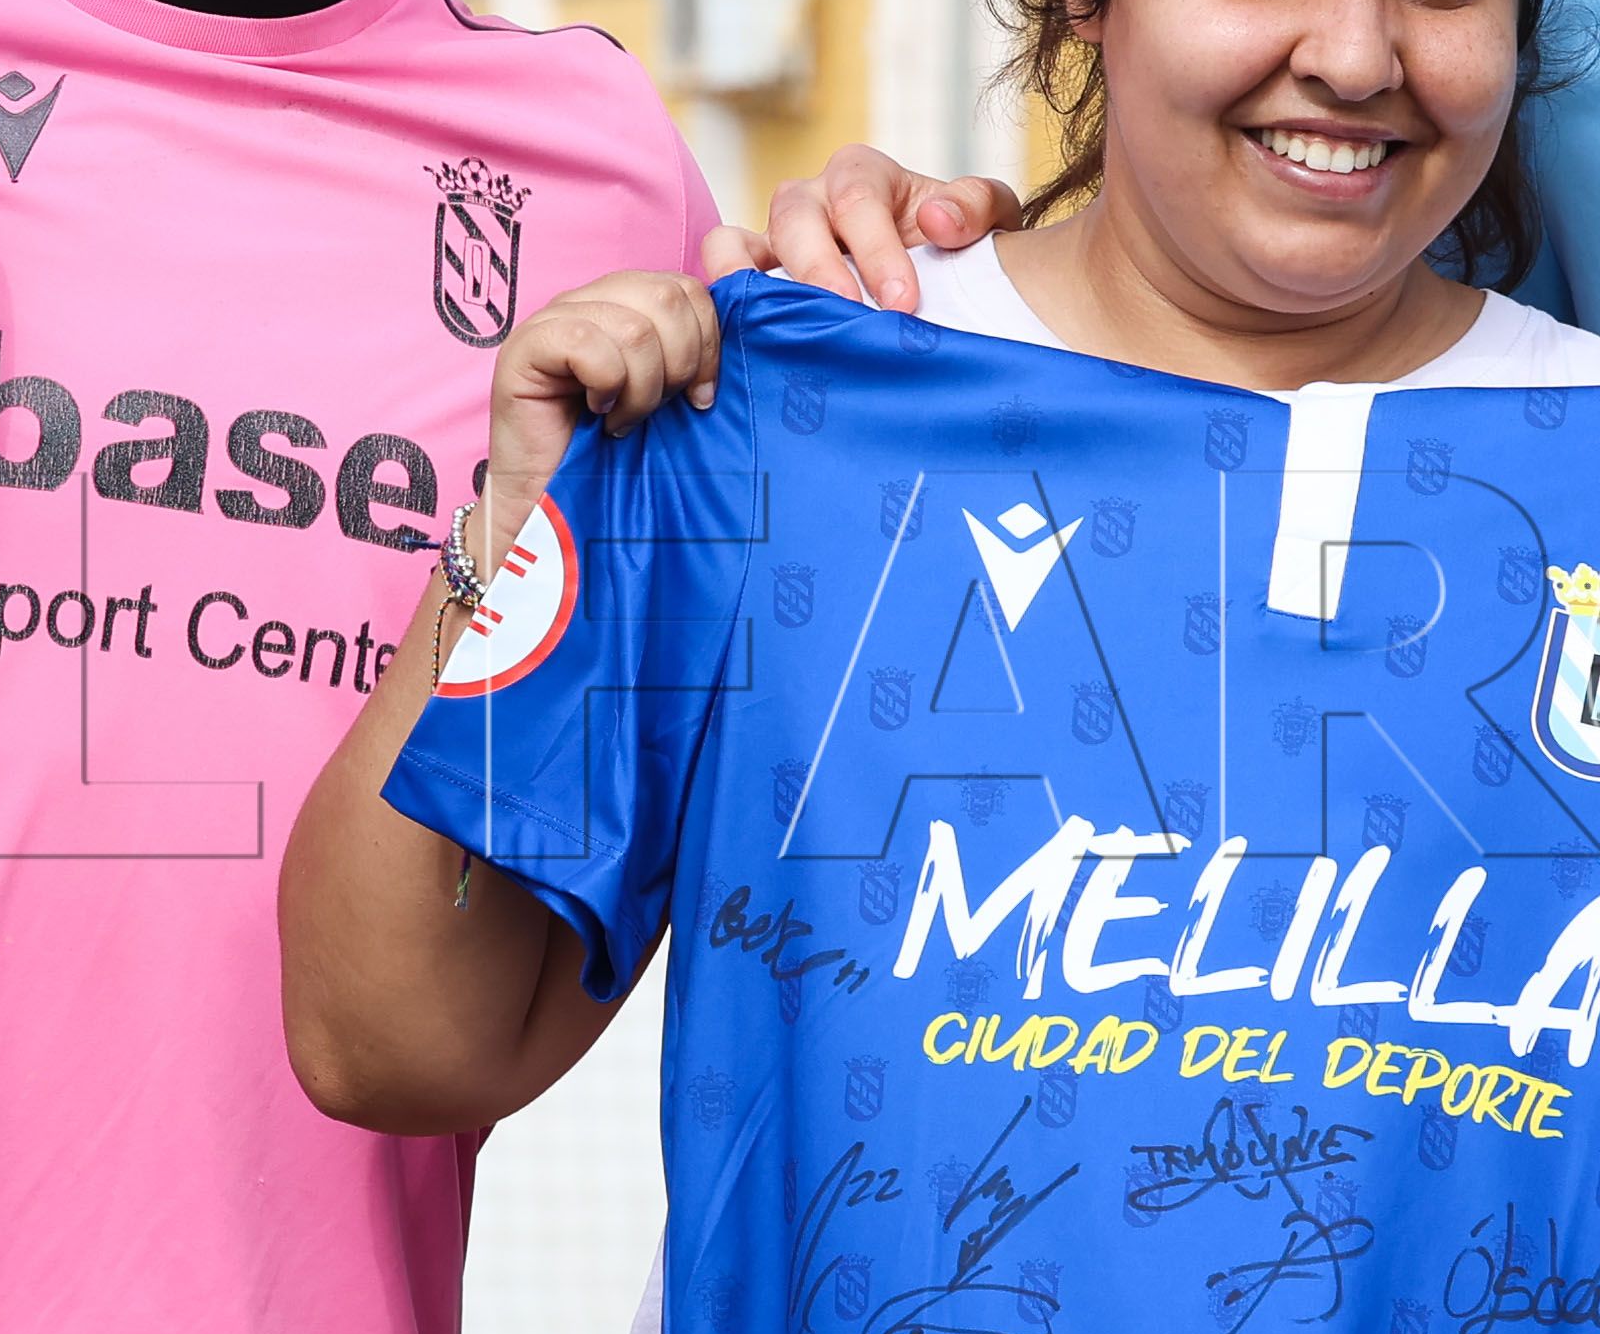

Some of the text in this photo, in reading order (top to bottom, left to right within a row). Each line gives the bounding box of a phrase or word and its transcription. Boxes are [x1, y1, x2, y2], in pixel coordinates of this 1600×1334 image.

[922, 1012, 1574, 1140] CIUDAD DEL DEPORTE
